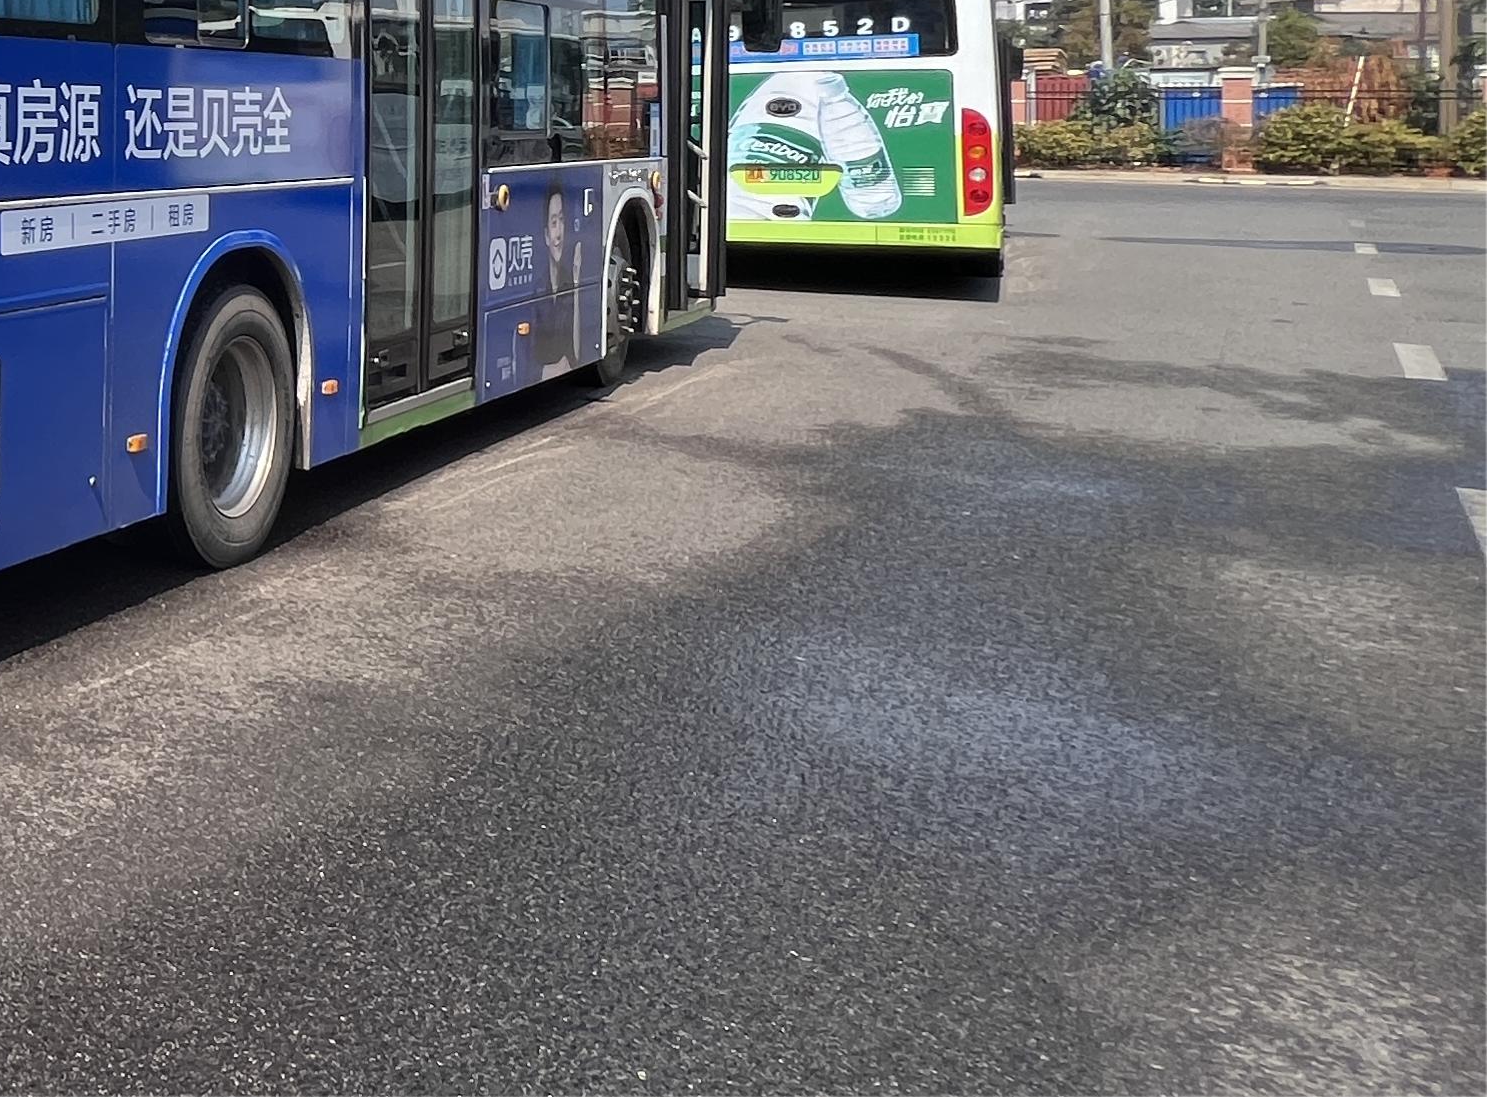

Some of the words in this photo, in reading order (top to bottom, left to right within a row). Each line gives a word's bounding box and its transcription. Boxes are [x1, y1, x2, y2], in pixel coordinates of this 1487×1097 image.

[865, 87, 925, 110] 你我的
[124, 84, 293, 161] 还是贝壳全
[20, 216, 54, 246] 新房
[91, 208, 136, 237] 二手房
[168, 203, 194, 227] 租房
[508, 235, 534, 273] 贝壳
